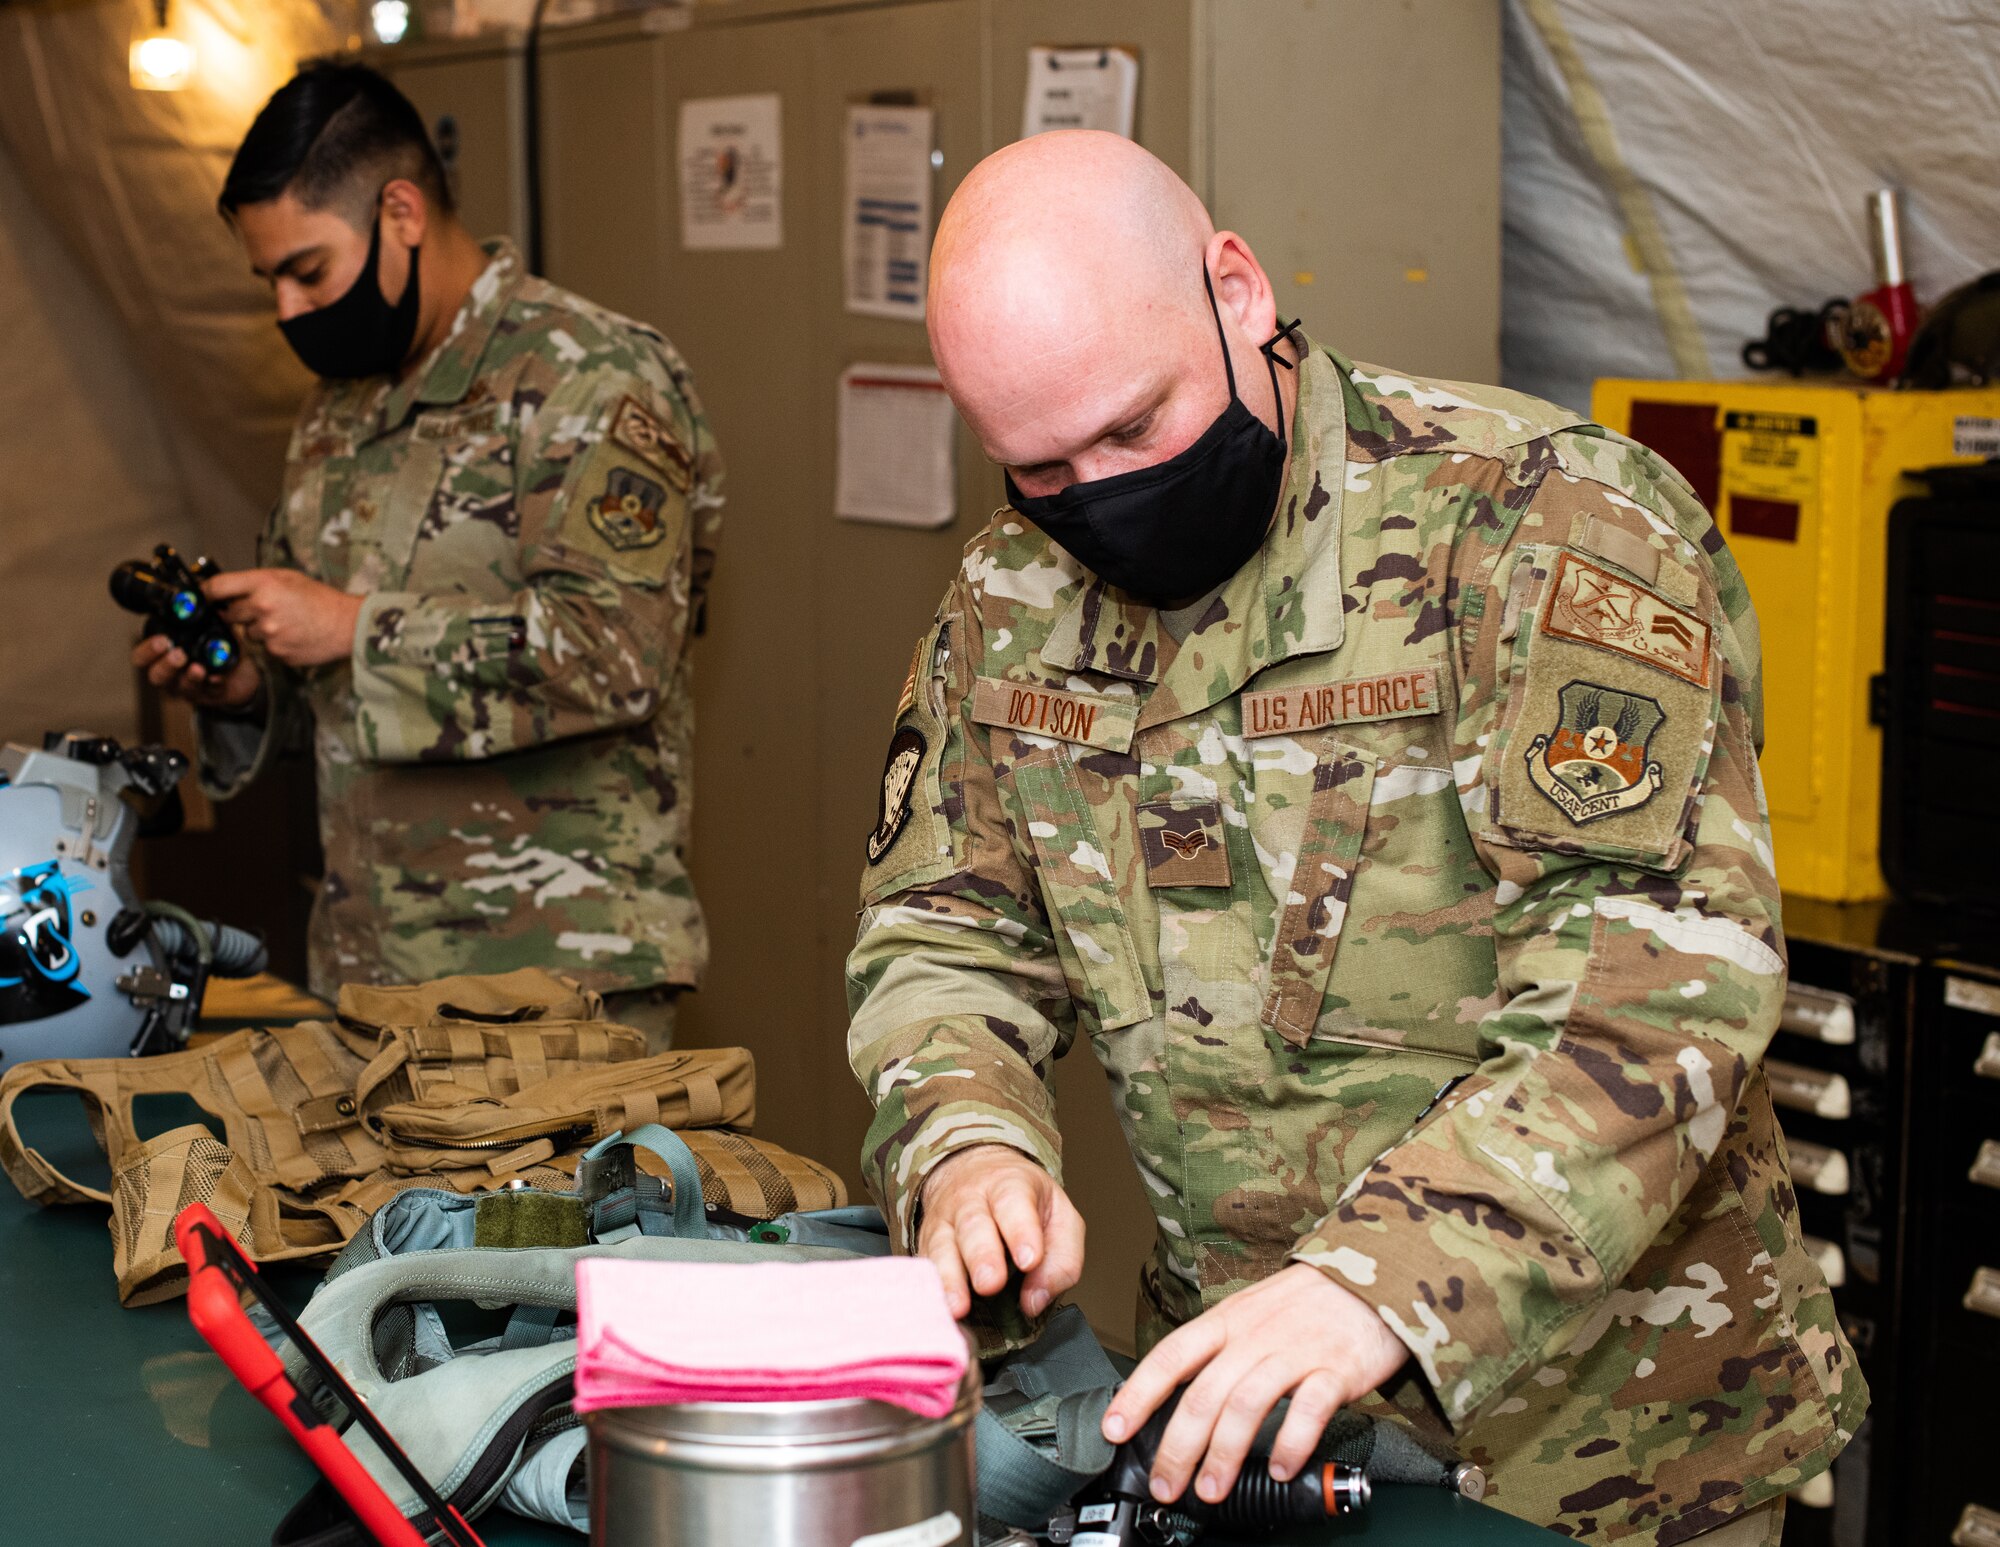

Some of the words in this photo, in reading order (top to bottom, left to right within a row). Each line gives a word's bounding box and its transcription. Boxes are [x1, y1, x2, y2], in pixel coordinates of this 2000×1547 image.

[1008, 689, 1096, 741] DOTSON
[1252, 695, 1291, 733] U.S.
[1299, 687, 1335, 727] AIR
[1342, 673, 1429, 720] FORCE
[1549, 781, 1620, 817] USAFCENT
